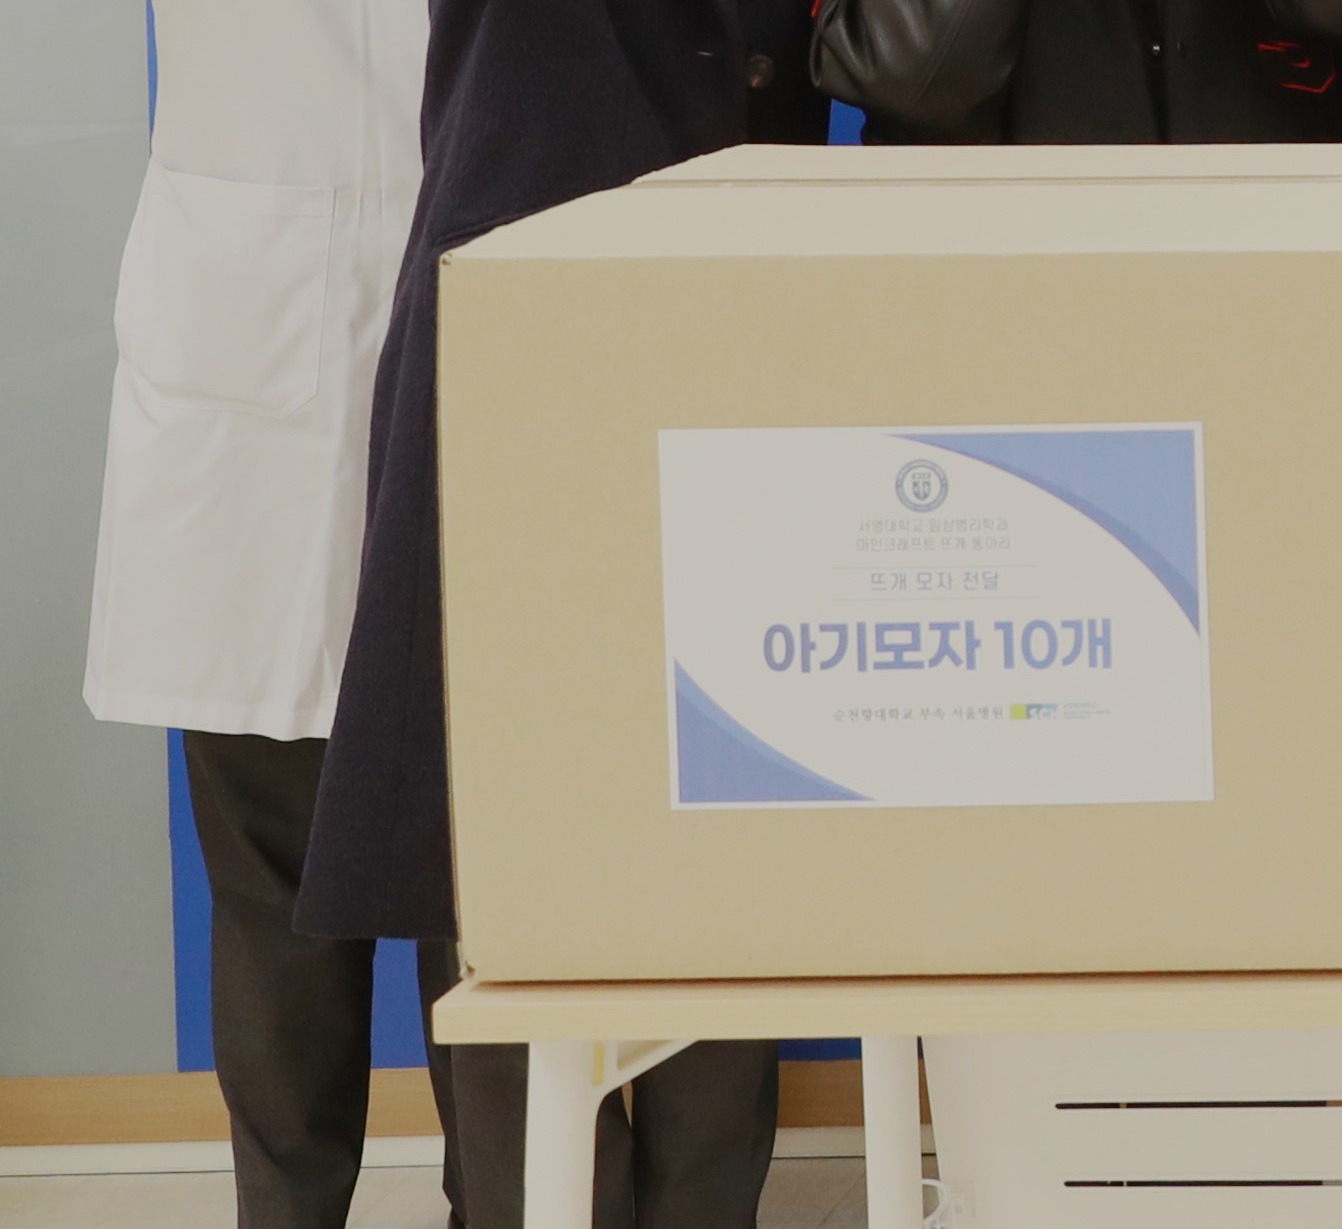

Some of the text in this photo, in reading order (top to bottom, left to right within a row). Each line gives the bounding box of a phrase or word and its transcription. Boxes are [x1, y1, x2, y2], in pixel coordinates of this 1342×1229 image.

[870, 571, 1000, 592] 뜨개 모자 전달
[763, 618, 1112, 673] 아기모자 10개
